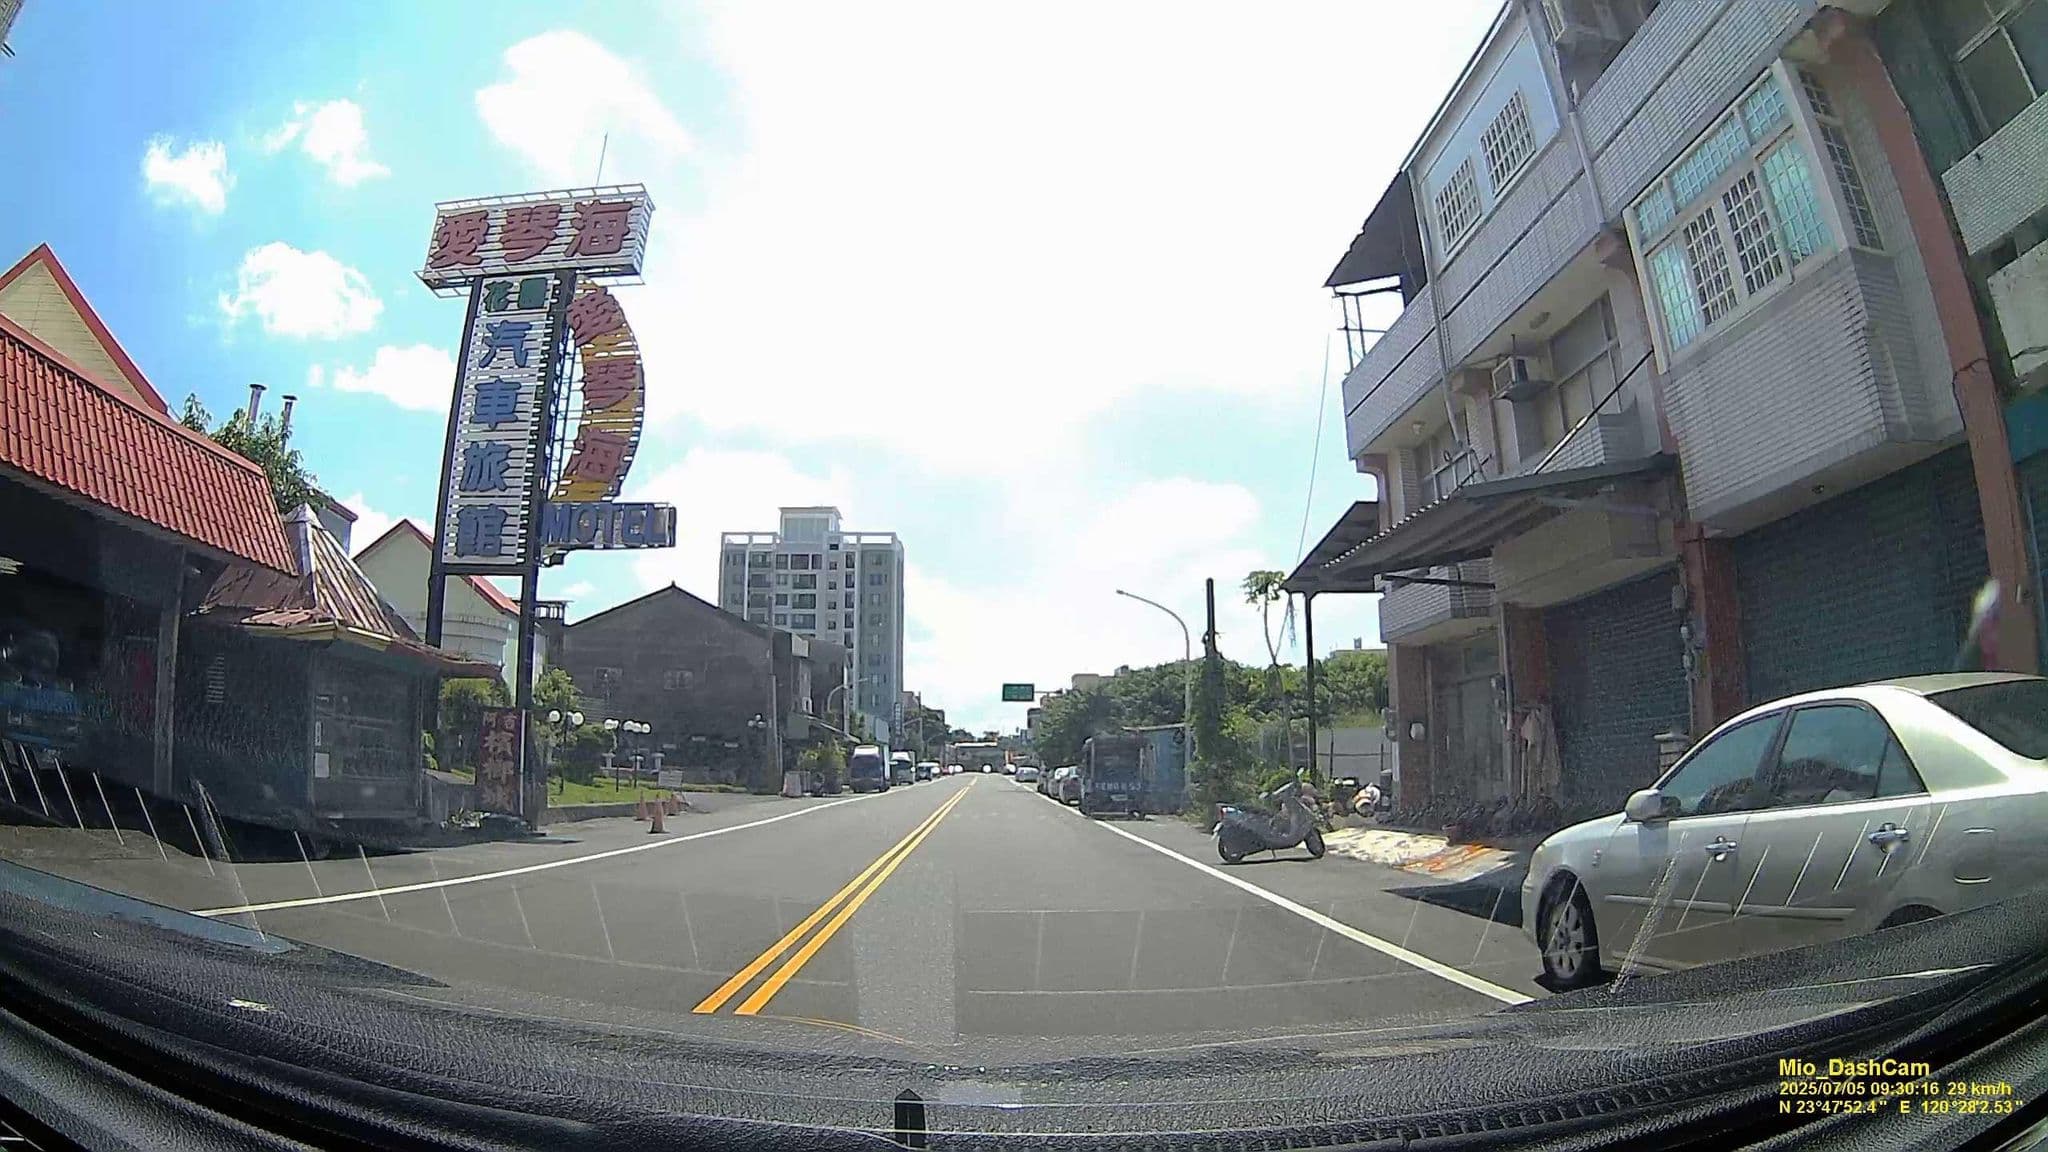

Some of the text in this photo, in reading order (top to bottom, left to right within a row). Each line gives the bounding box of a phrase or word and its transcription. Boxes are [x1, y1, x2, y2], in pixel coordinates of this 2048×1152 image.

[430, 200, 634, 269] 愛琴海
[457, 319, 532, 558] 汽車旅館
[566, 287, 637, 483] 愛琴海
[542, 503, 667, 546] MOTEL
